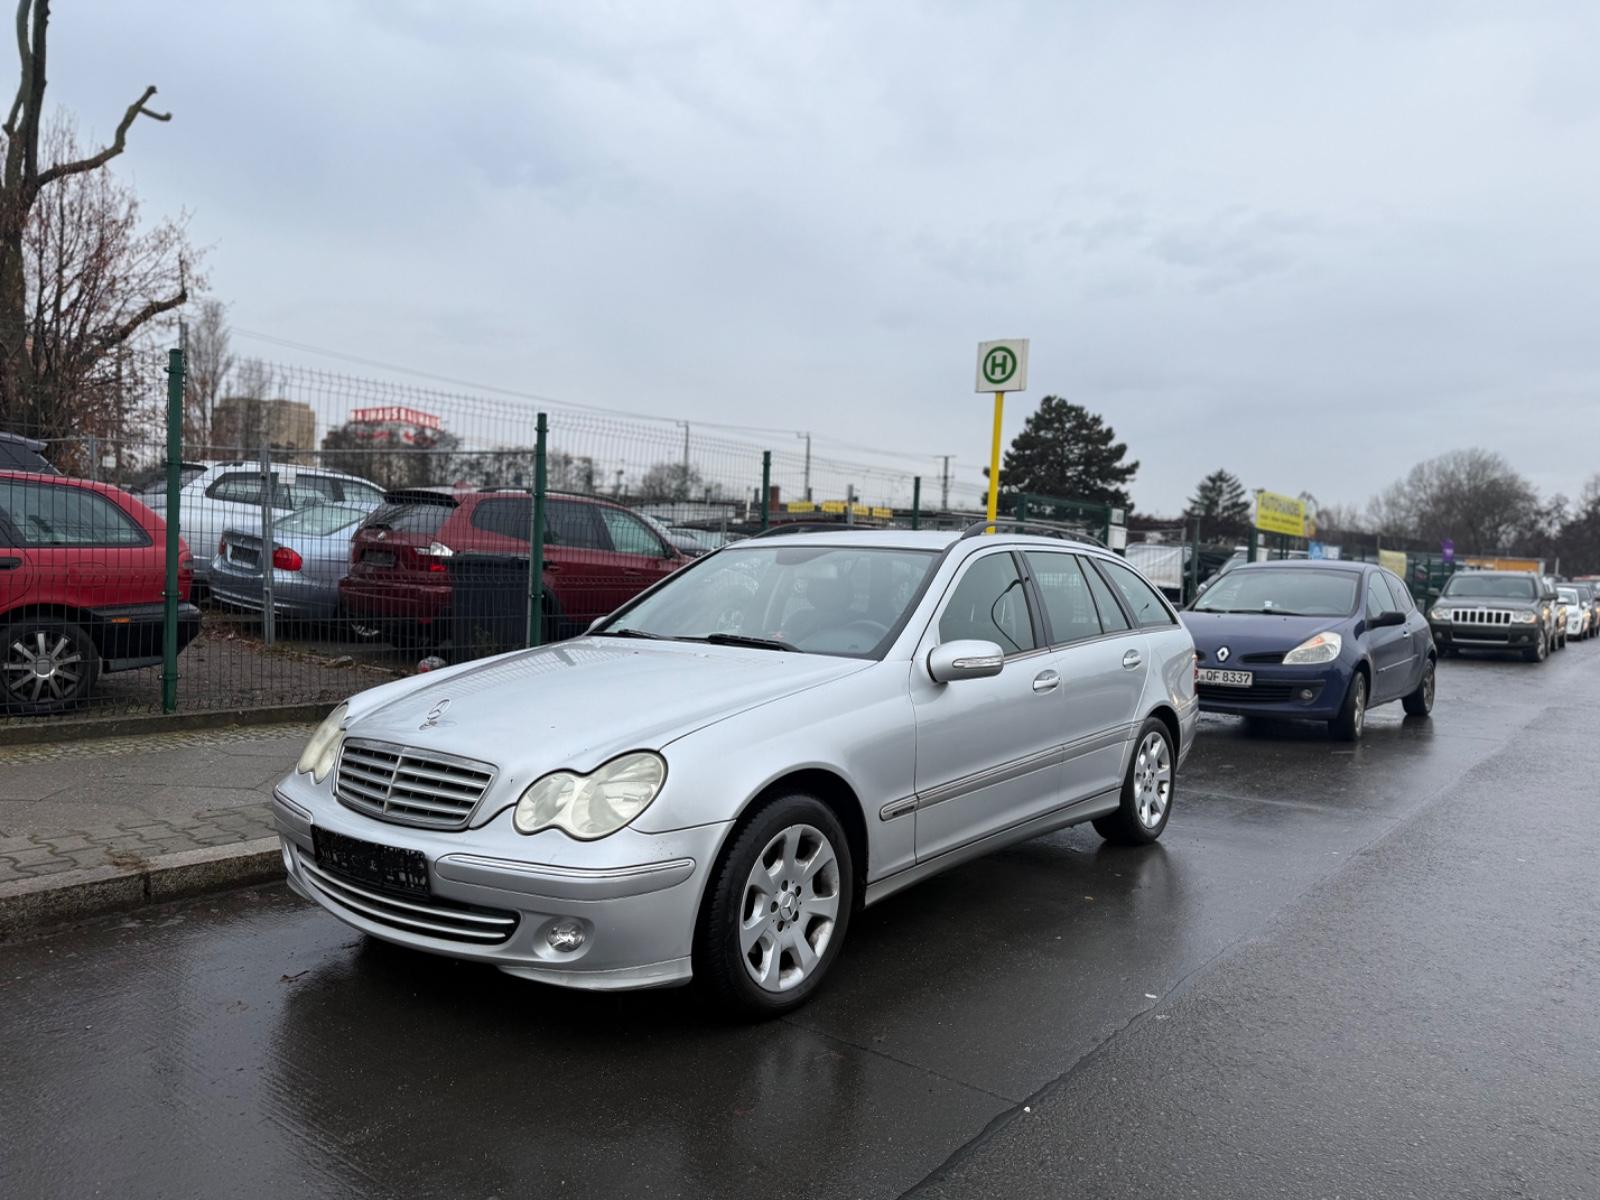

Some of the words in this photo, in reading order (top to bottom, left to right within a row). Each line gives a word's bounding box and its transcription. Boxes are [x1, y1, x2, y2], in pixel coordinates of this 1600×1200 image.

[990, 354, 1008, 376] H
[1206, 670, 1220, 681] QF
[1222, 672, 1250, 684] 8337
